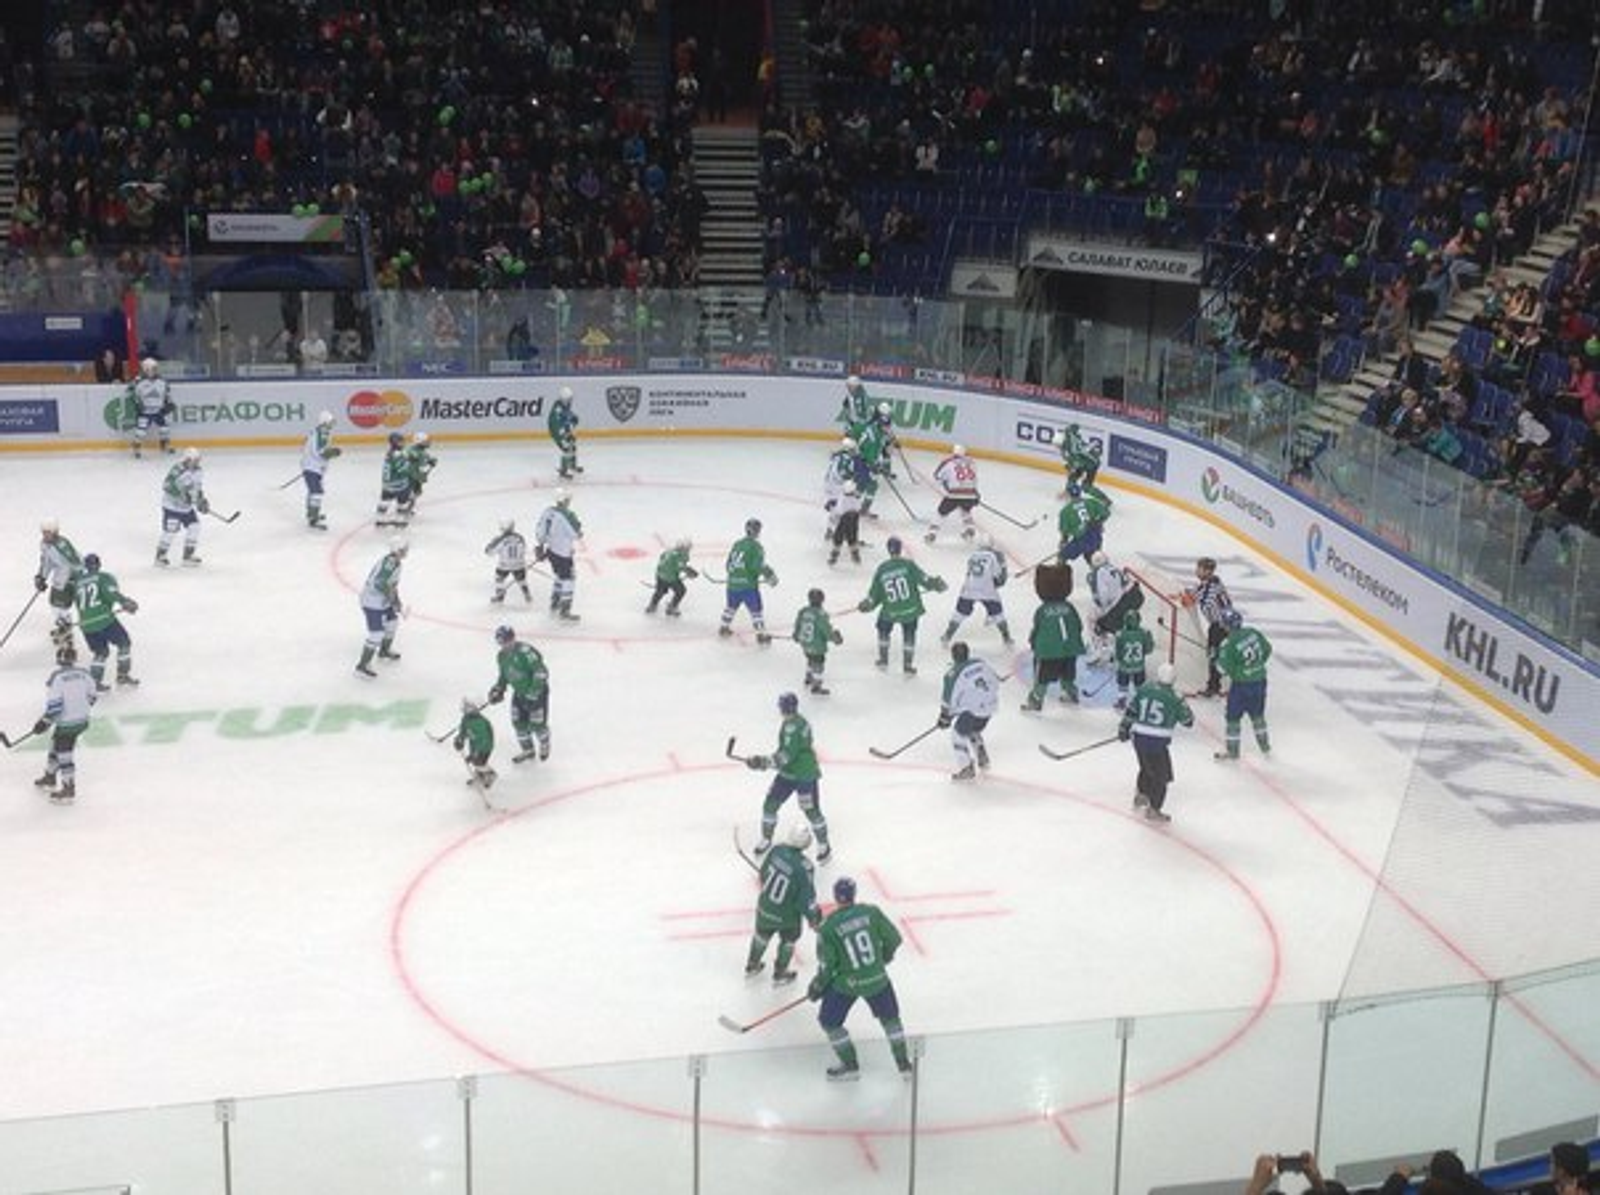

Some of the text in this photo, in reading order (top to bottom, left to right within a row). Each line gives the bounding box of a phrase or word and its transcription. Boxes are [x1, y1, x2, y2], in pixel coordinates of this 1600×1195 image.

[1067, 251, 1132, 269] САЛАВАТ
[420, 397, 543, 419] MasterCard
[884, 576, 911, 602] 50
[1123, 643, 1143, 661] 23
[1445, 612, 1560, 714] KHL.RU
[1139, 698, 1165, 725] 15
[844, 930, 876, 970] 19
